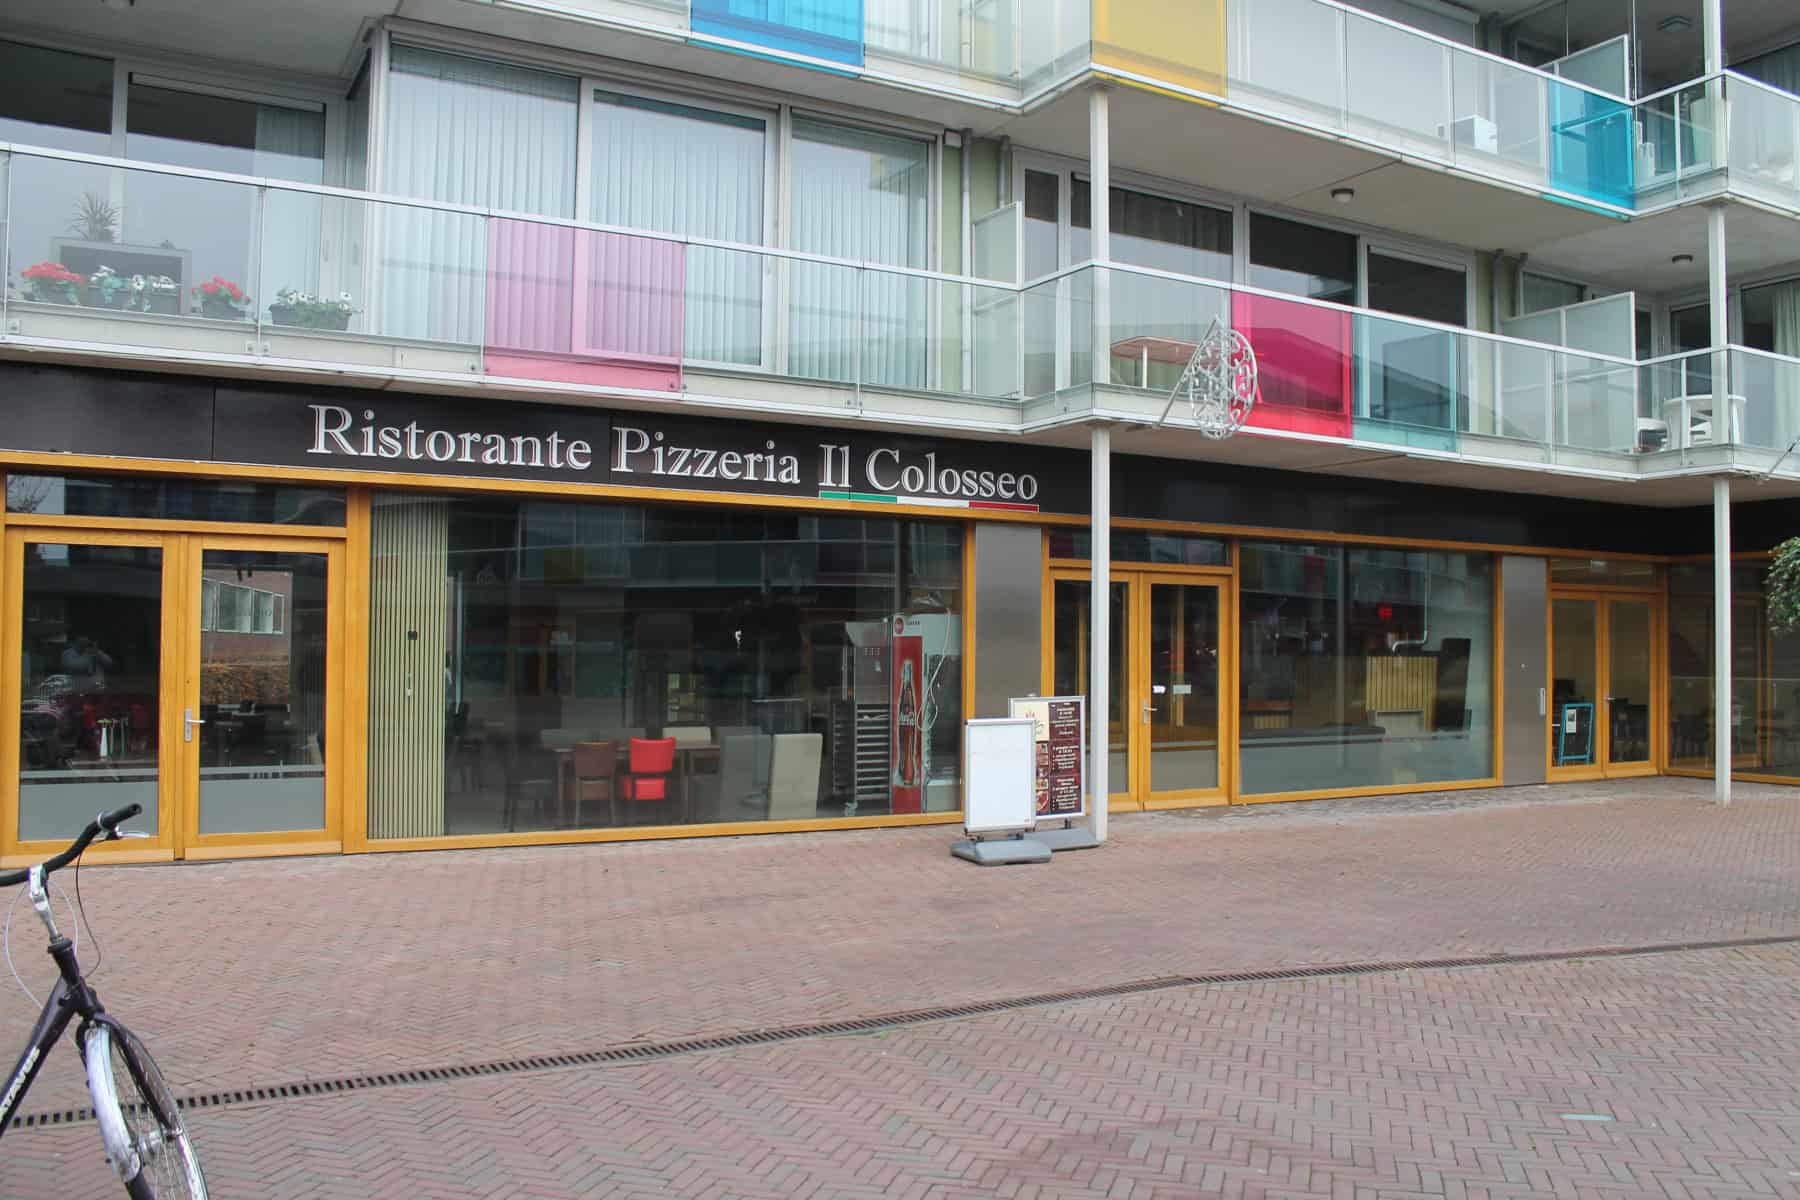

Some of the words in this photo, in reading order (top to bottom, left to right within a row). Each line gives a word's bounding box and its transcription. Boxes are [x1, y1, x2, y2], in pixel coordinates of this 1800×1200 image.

[306, 404, 592, 470] Ristorante
[611, 426, 801, 484] Pizzeria
[818, 444, 852, 488] Il
[865, 448, 1039, 500] Colosseo
